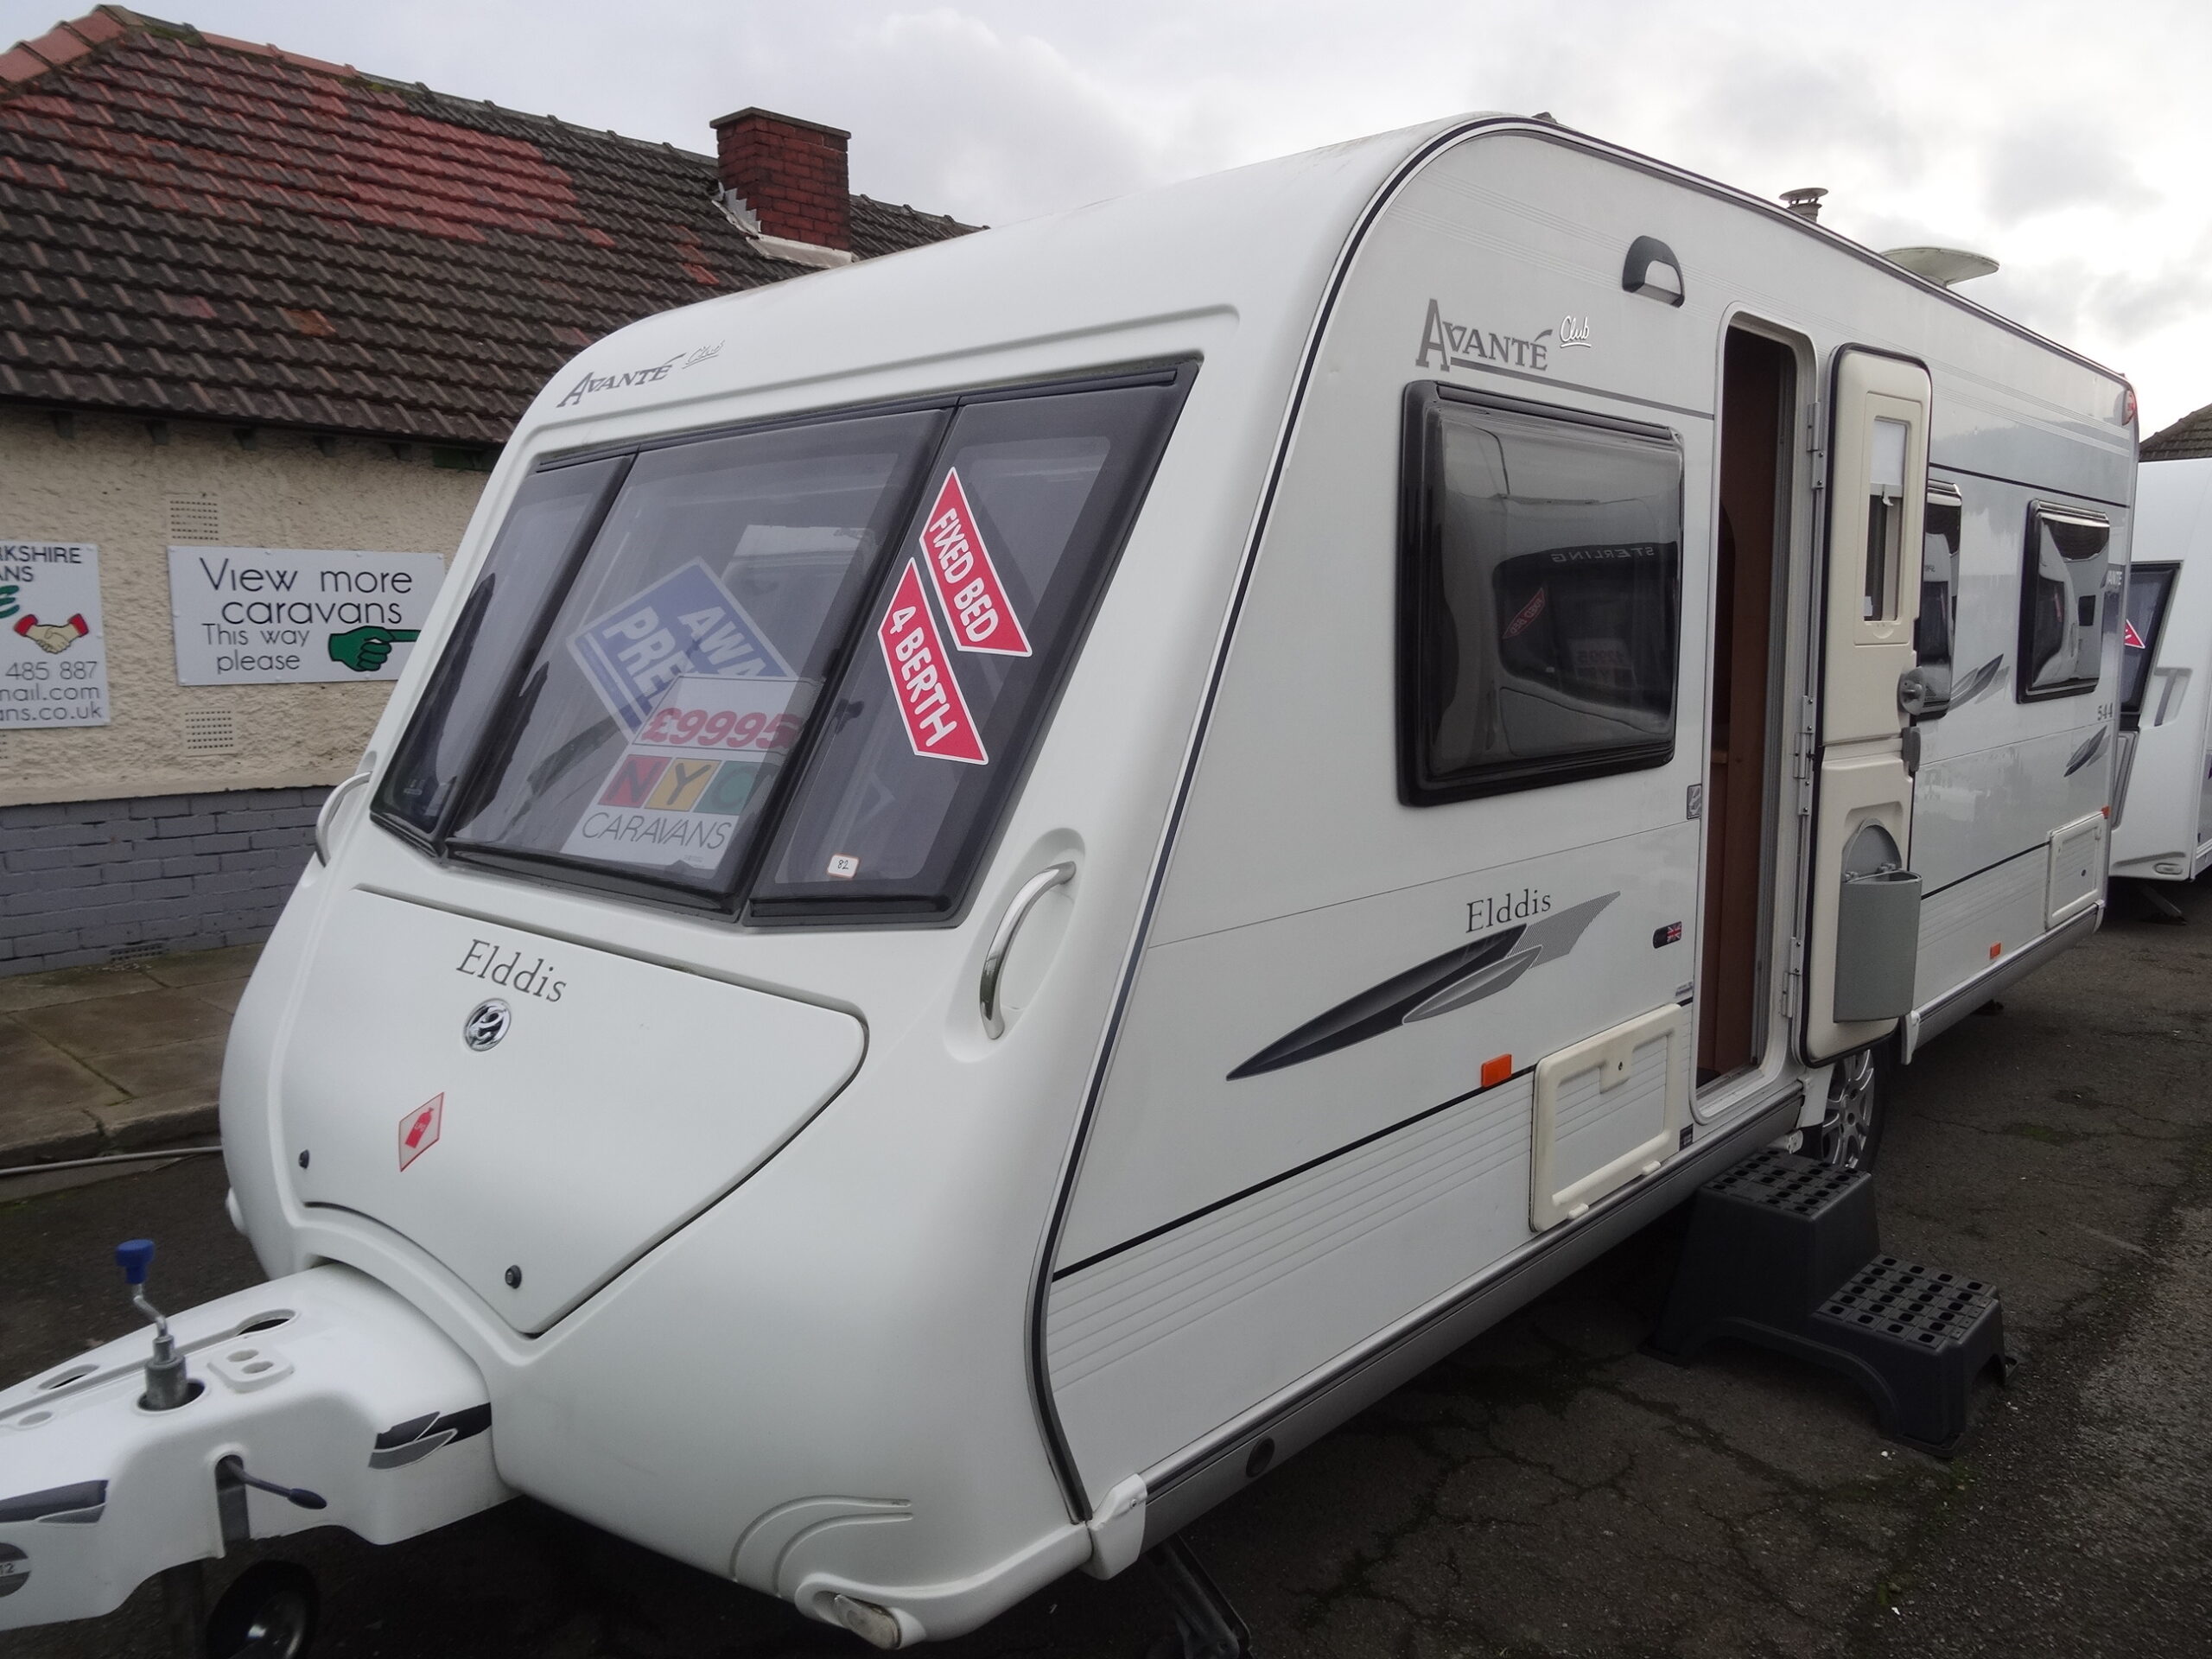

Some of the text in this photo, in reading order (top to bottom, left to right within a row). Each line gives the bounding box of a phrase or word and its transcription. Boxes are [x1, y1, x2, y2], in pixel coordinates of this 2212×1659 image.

[1559, 315, 1591, 343] Club
[0, 545, 81, 563] KSHIRE
[0, 565, 34, 582] NS
[199, 557, 412, 594] View more
[929, 507, 999, 642] FIXED BED
[221, 601, 402, 625] caravans
[201, 623, 309, 648] This way
[217, 649, 300, 675] please
[602, 606, 695, 702] PRE
[5, 660, 98, 681] 485 887
[890, 606, 957, 747] 4 BERTH
[641, 707, 804, 749] £9995
[582, 811, 733, 850] CARAVANS
[837, 859, 849, 870] 82
[1465, 887, 1552, 934] Elddis
[455, 938, 567, 1002] Elddis
